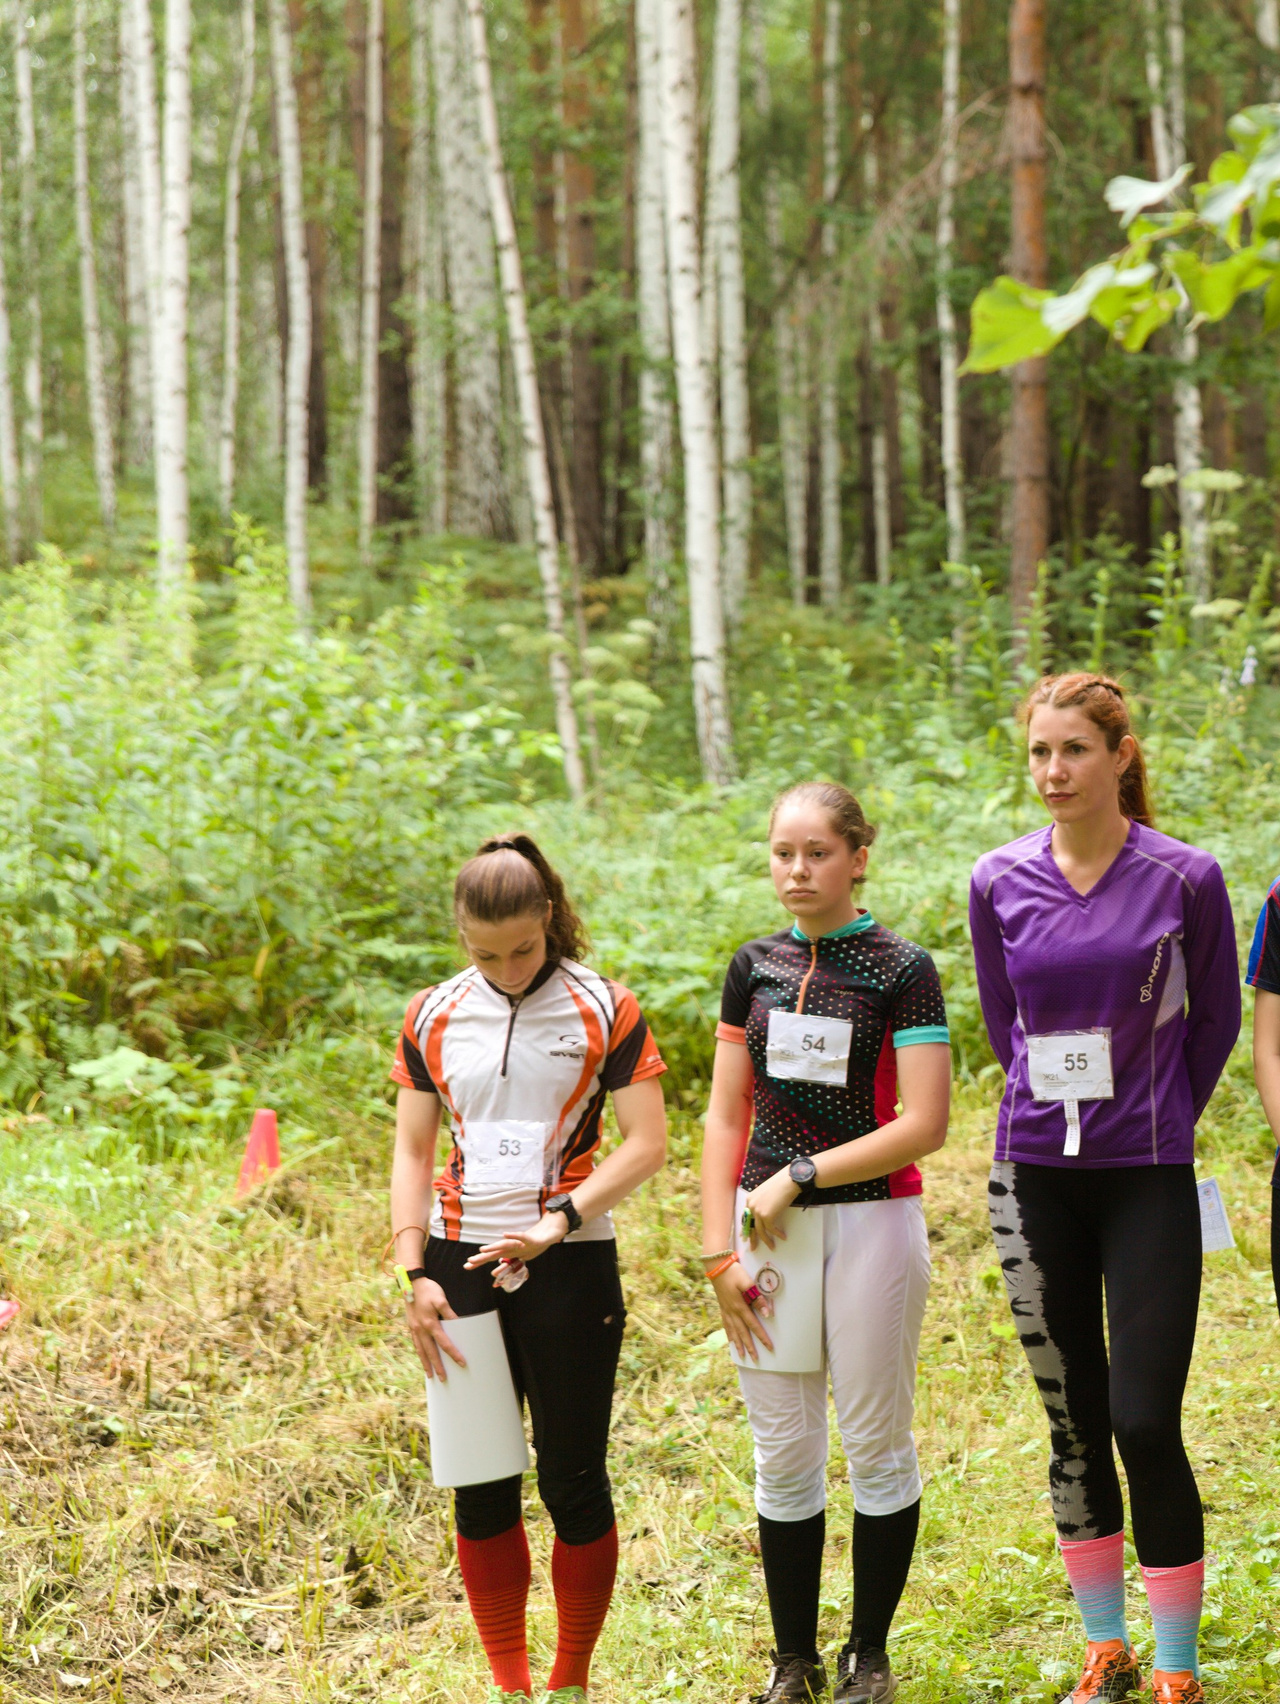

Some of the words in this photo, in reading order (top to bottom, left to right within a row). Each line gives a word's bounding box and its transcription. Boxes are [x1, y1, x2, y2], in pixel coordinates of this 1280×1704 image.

[801, 1033, 826, 1054] 54
[1064, 1052, 1088, 1071] 55
[1042, 1073, 1059, 1081] Ж21
[499, 1139, 522, 1157] 53
